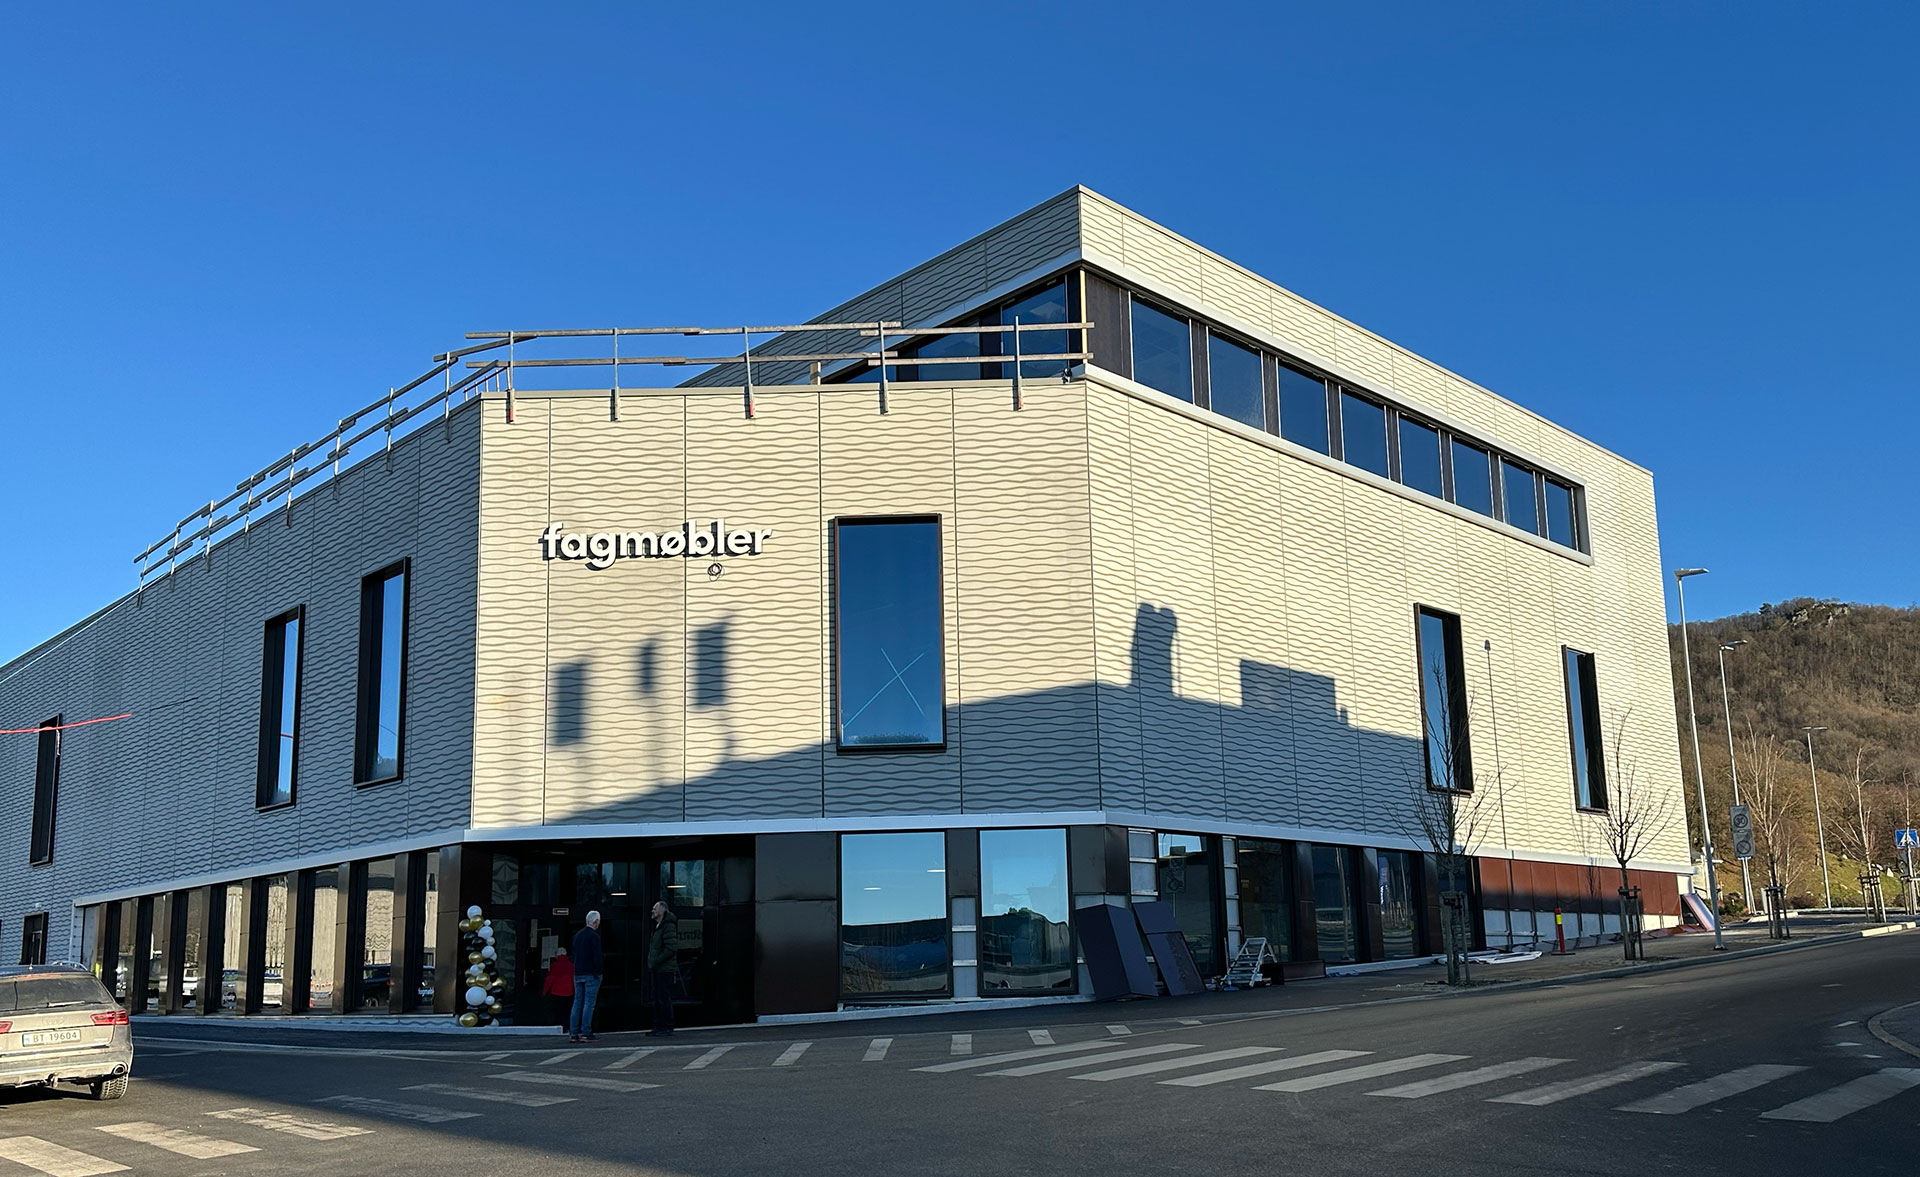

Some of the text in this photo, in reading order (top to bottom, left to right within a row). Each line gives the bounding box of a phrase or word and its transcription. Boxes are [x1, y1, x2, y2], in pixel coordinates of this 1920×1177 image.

[542, 518, 773, 569] fagmøbler
[33, 1032, 77, 1043] BT 19604
